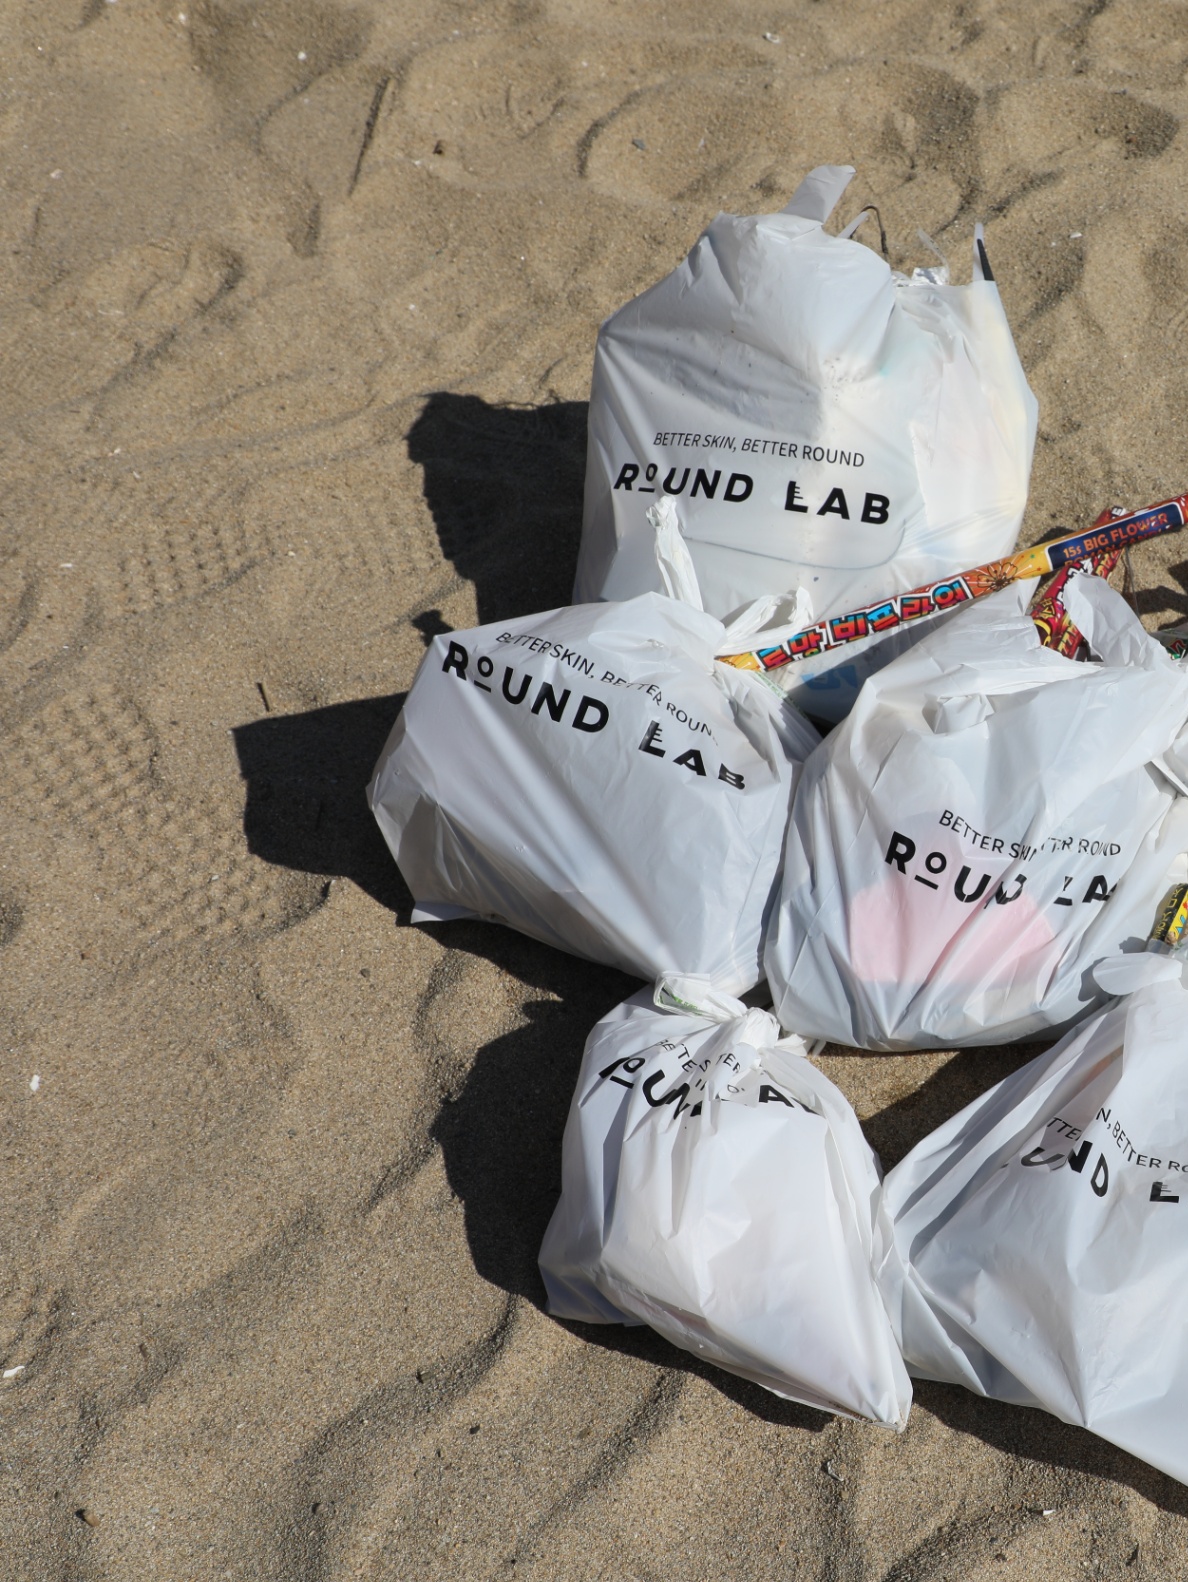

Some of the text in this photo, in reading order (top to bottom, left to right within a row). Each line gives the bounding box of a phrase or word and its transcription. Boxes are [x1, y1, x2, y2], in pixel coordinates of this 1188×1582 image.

[653, 432, 865, 467] BETTER SKIN, BETTER ROUND
[613, 462, 891, 525] ROUND LAB
[1083, 533, 1109, 552] BIG
[1110, 512, 1169, 542] FLOWER
[495, 631, 719, 747] BETTER SKIN, BETTER ROUN
[442, 640, 746, 790] ROUND LAB
[939, 809, 1005, 854] BETTER
[1111, 1120, 1162, 1169] BETTER
